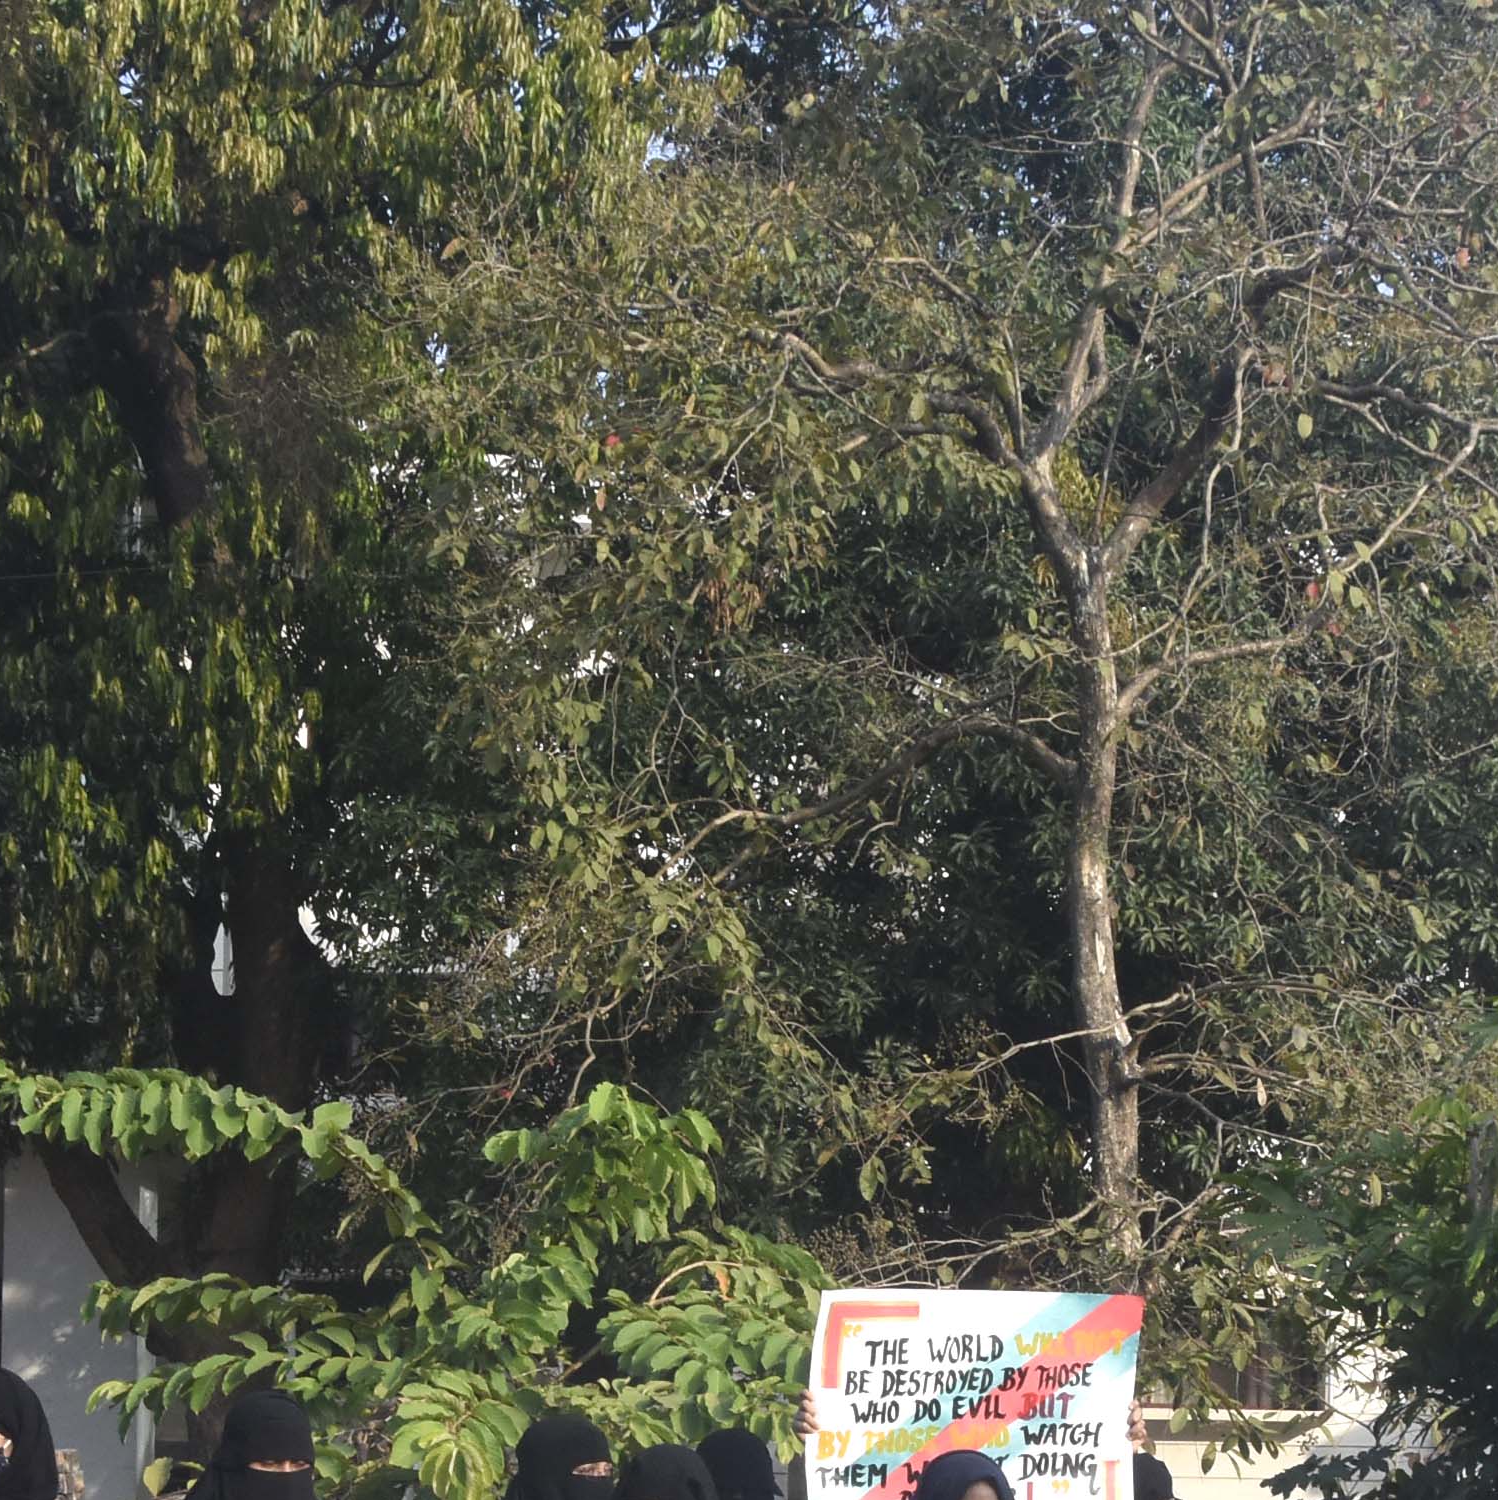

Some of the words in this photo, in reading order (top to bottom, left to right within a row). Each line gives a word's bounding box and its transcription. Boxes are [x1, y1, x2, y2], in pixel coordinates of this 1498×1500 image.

[865, 1337, 910, 1367] THE
[927, 1334, 1004, 1365] WORLD
[844, 1370, 874, 1396] BE
[880, 1369, 994, 1399] DESTROYED
[997, 1366, 1029, 1392] BY
[1035, 1362, 1094, 1390] THOSE
[850, 1400, 900, 1425] WHO
[911, 1398, 941, 1425] DO
[951, 1396, 1007, 1420] EVIL
[1017, 1391, 1076, 1421] BUT
[816, 1428, 850, 1460] BY
[863, 1426, 943, 1455] THOSE
[949, 1422, 1012, 1450] WHO
[1019, 1422, 1103, 1448] WATCH
[815, 1463, 888, 1489] THEM
[1017, 1452, 1101, 1496] DOING
